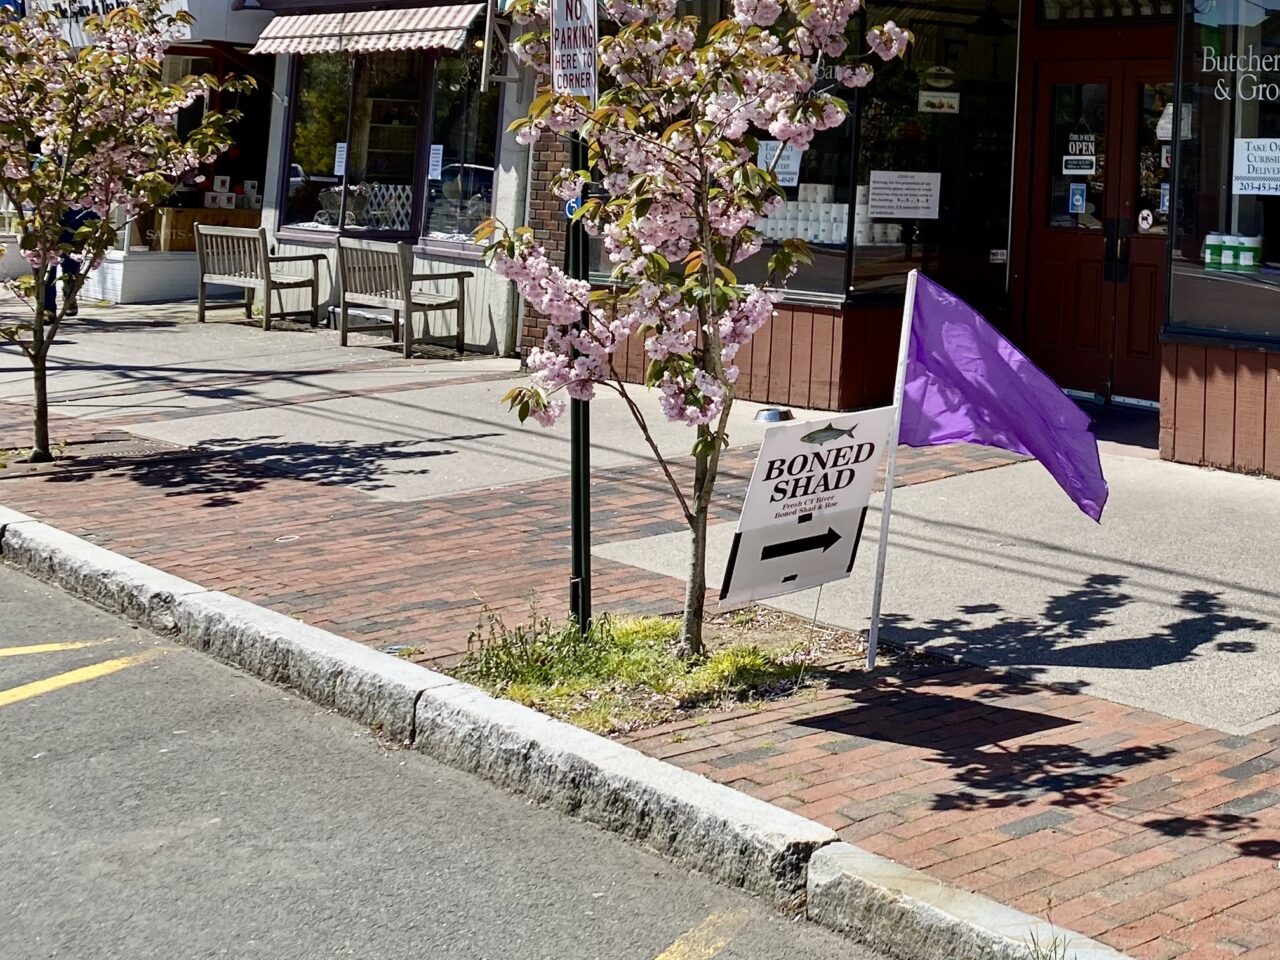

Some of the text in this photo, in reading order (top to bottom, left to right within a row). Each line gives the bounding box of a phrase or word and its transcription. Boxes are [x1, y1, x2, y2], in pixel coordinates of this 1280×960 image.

[554, 24, 593, 50] PARKING
[555, 52, 593, 70] HERE TO
[557, 72, 591, 89] CORNER
[1214, 78, 1232, 100] &
[1069, 141, 1095, 154] OPEN
[145, 229, 186, 240] SATS
[762, 441, 876, 482] BONED
[769, 468, 856, 504] SHAD
[775, 509, 798, 519] Boned
[799, 505, 817, 514] Shad
[825, 501, 838, 509] Roe
[782, 501, 803, 510] Fresh
[816, 495, 836, 504] River
